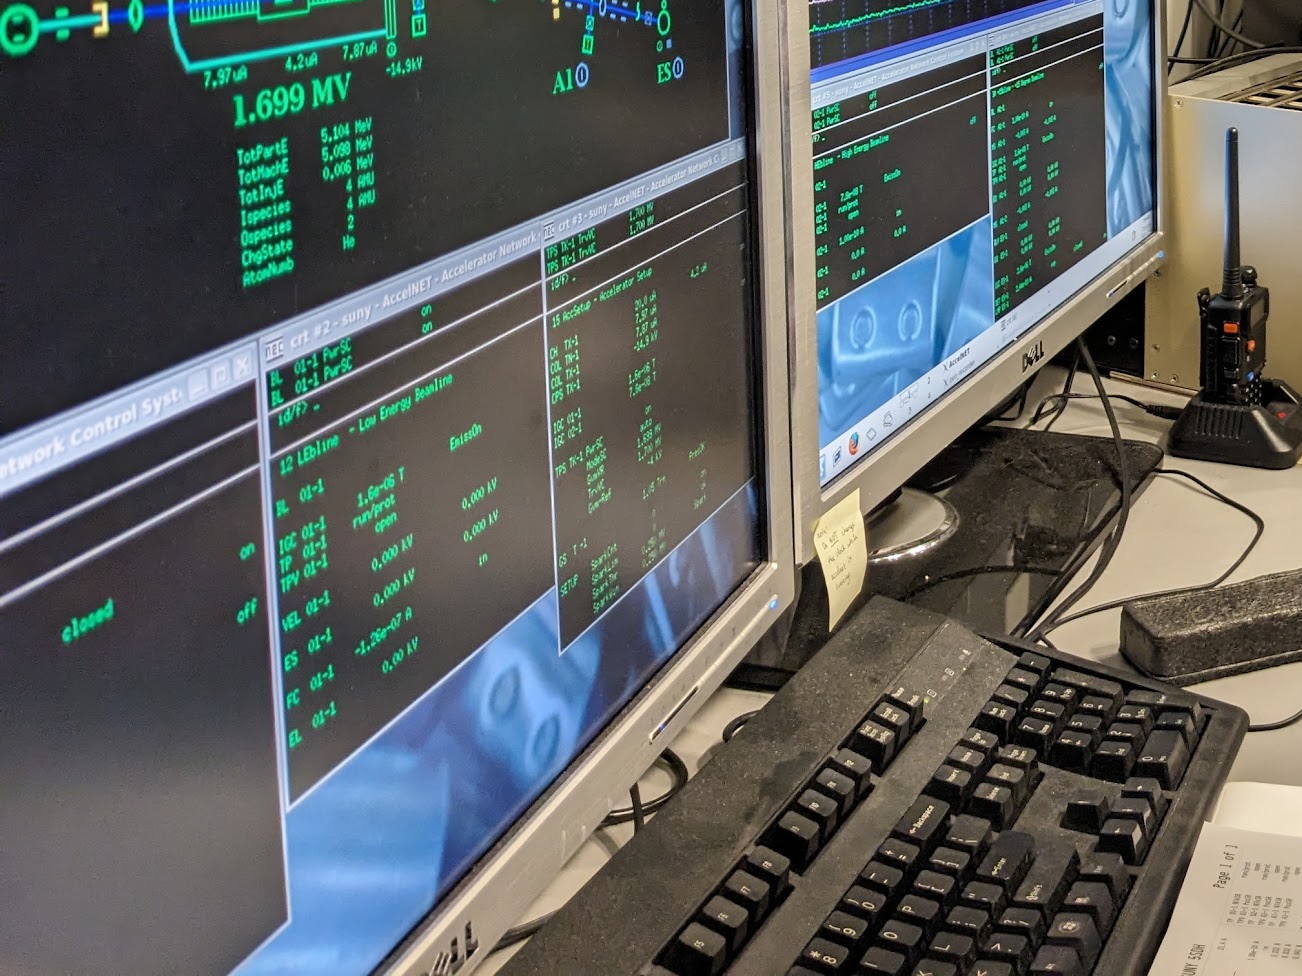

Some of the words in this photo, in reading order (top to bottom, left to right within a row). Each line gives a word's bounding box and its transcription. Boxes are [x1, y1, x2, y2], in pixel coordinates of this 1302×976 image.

[656, 61, 672, 84] ES
[233, 83, 305, 127] 1.699
[312, 73, 351, 109] MV
[321, 123, 349, 144] 5.104
[355, 117, 372, 135] MeV
[237, 138, 288, 166] TotPartE
[321, 141, 350, 162] 5.098
[356, 136, 373, 152] MeV
[238, 158, 289, 186] TotMachE
[322, 161, 352, 181] 0.006
[357, 154, 373, 171] MeV
[239, 179, 284, 206] TotInjE
[346, 179, 352, 193] 4
[357, 172, 375, 189] AMU
[347, 196, 353, 211] 4
[358, 190, 375, 207] AMU
[558, 219, 569, 232] crt
[572, 213, 582, 225] #3
[589, 200, 608, 220] suny
[613, 186, 646, 208] AccelNET
[651, 170, 686, 192] Accelerator
[687, 159, 713, 176] Network
[241, 200, 290, 226] Ispecies
[348, 215, 354, 229] 2
[240, 220, 291, 247] Ospecies
[342, 236, 355, 251] He
[242, 238, 293, 268] ChgState
[243, 259, 294, 288] AtomNumb
[290, 331, 310, 349] crt
[314, 320, 330, 340] #2
[342, 303, 371, 328] suny
[382, 276, 432, 308] AccelNET
[442, 250, 498, 283] Accelerator
[500, 231, 536, 256] Network
[421, 304, 431, 317] on
[422, 321, 432, 334] on
[270, 371, 283, 386] BL
[271, 390, 284, 407] BL
[70, 404, 137, 448] Control
[280, 456, 293, 475] 12
[359, 414, 376, 432] Low
[380, 394, 412, 422] Energy
[415, 373, 453, 400] Beamline
[276, 499, 289, 518] BL
[240, 542, 255, 560] on
[478, 553, 488, 566] in
[280, 556, 292, 574] TP
[237, 596, 258, 624] off
[284, 651, 298, 671] ES
[287, 688, 300, 710] FC
[288, 727, 302, 748] EL
[1213, 871, 1230, 889] Page
